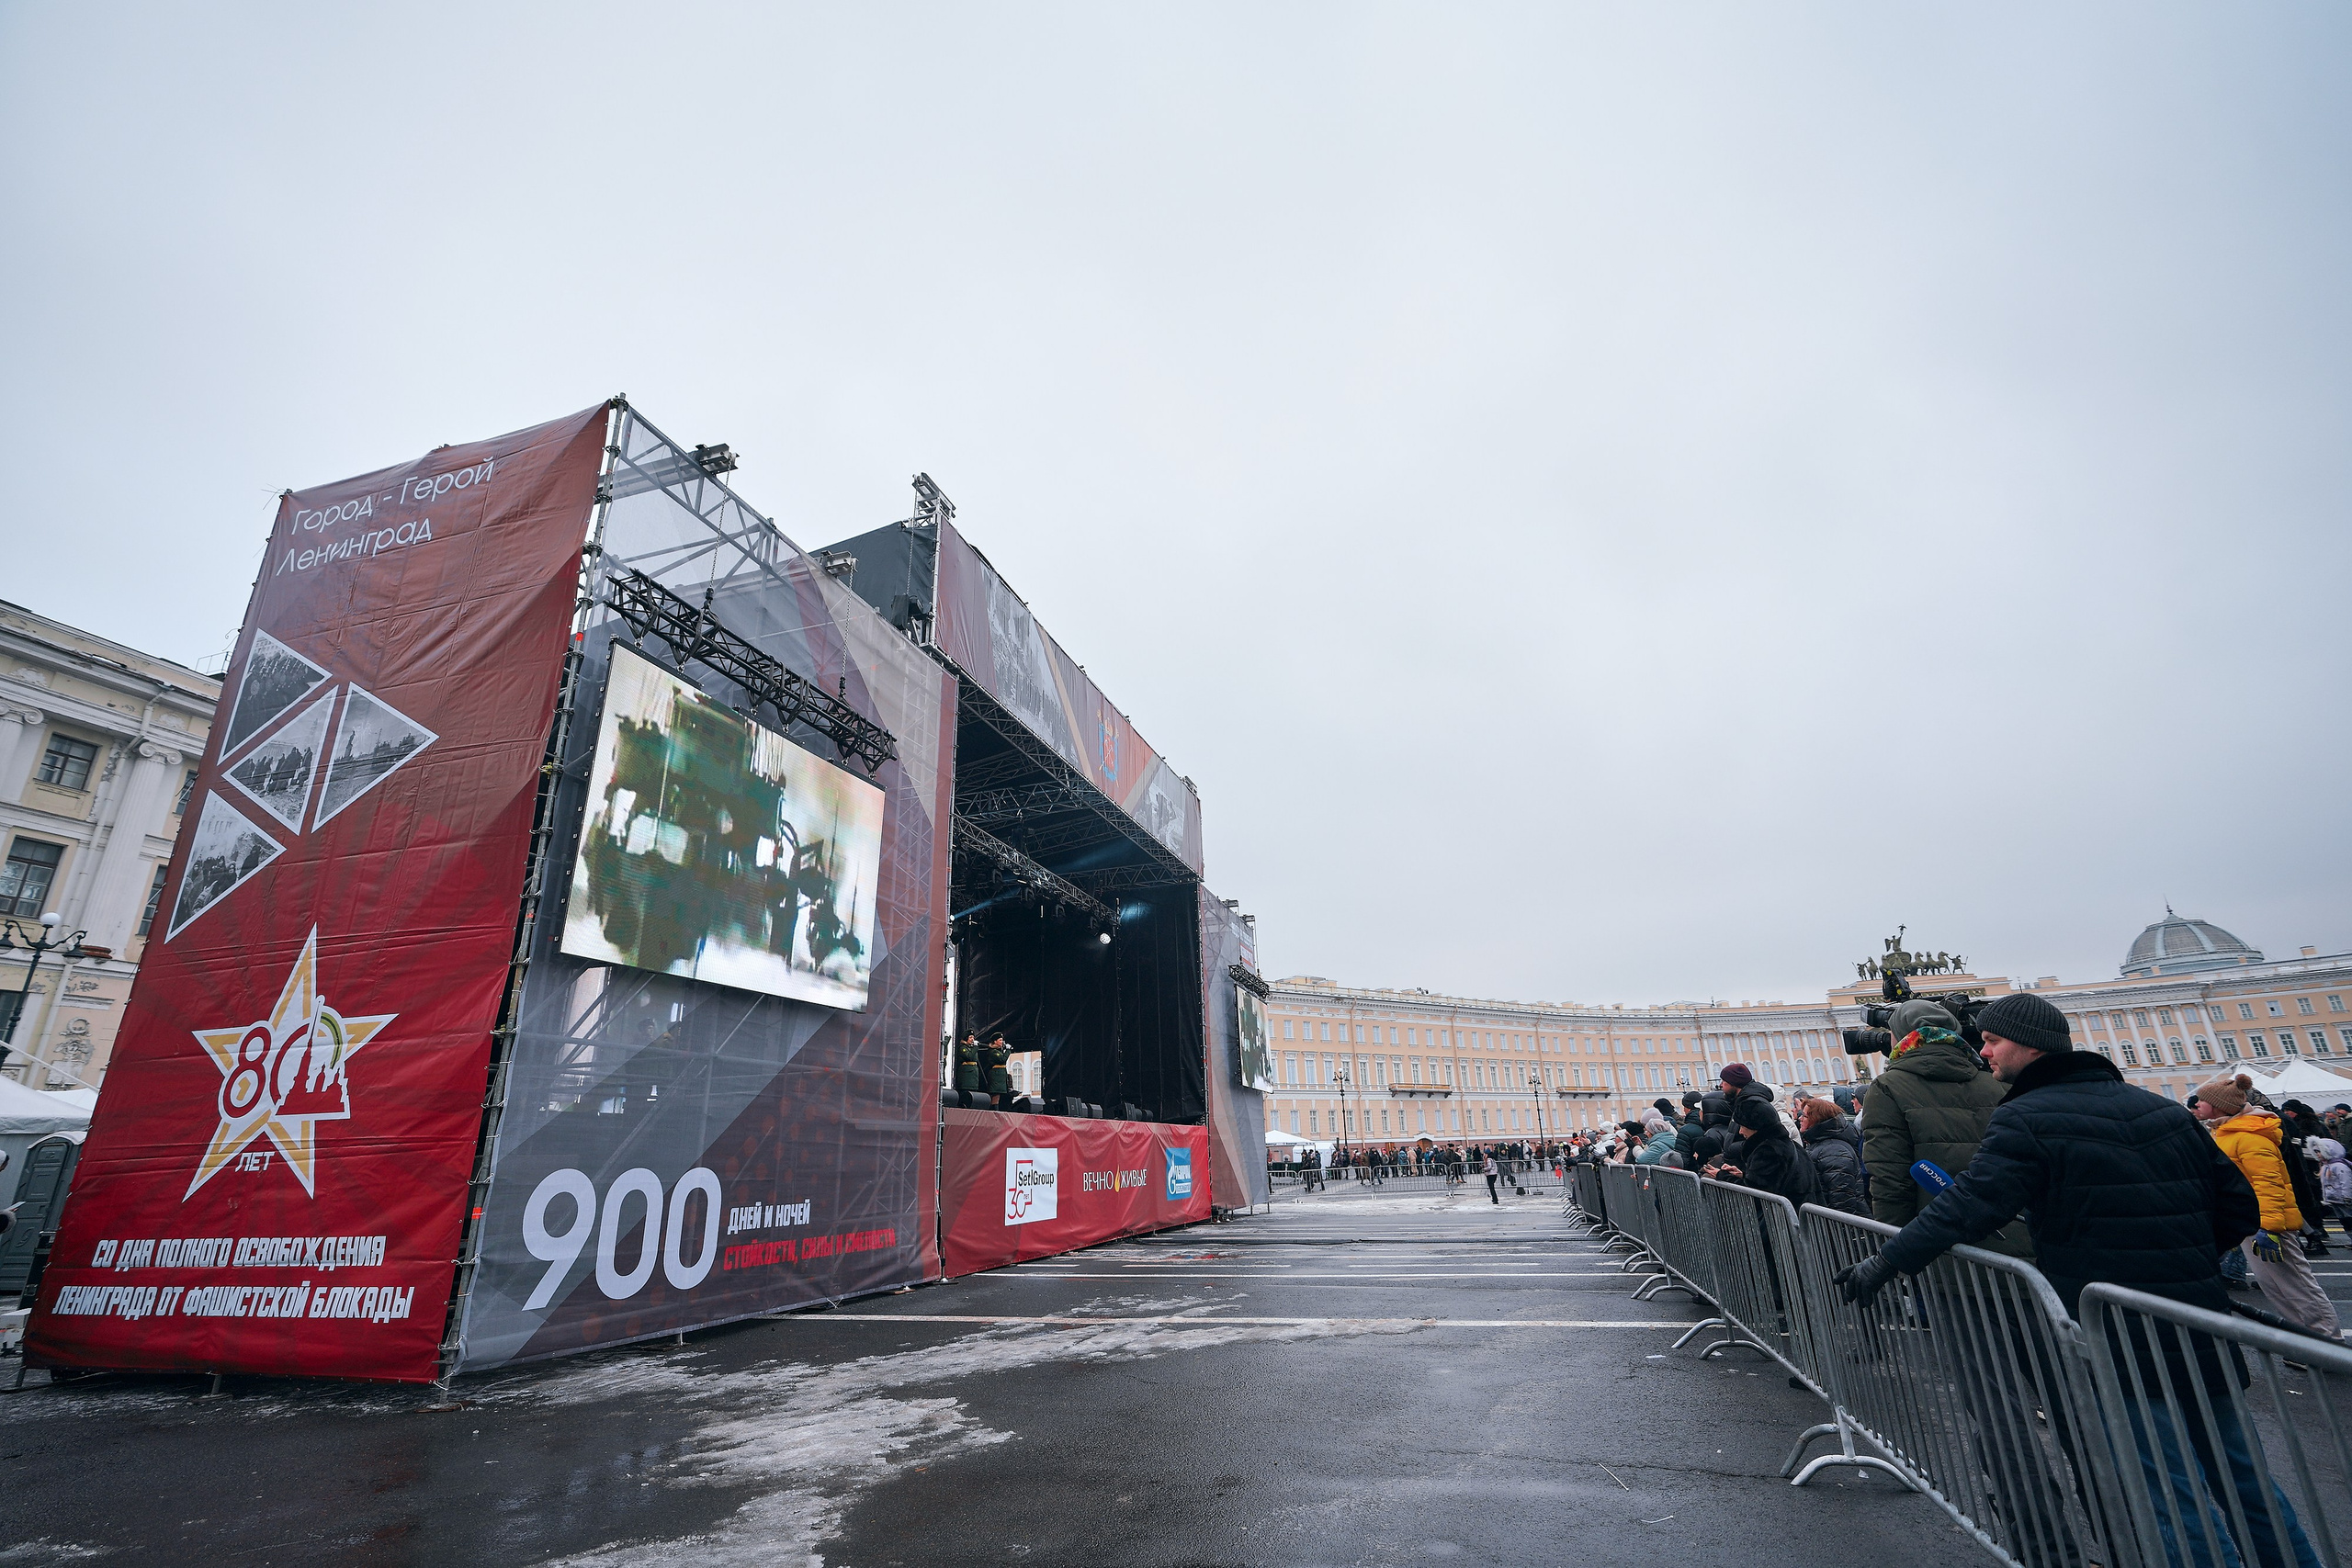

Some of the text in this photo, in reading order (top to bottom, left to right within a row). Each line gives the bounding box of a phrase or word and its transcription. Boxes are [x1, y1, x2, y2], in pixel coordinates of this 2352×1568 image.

[291, 494, 373, 536] Город
[399, 457, 495, 504] Герой
[276, 517, 433, 576] Ленинград
[234, 1151, 276, 1173] ЛЕТ
[1082, 1168, 1148, 1192] ВЕЧНО ЖИВЫЕ
[1918, 1163, 1947, 1187] РОССИЯ
[727, 1199, 811, 1235] ДНЕЙ И НОЧЕЙ
[91, 1235, 387, 1272] СО ДНЯ ПОЛНОГО ОСВОБОЖДЕНИЯ
[521, 1167, 723, 1312] 900
[723, 1228, 897, 1271] СТОЙКОСТИ, СИЛЫ И СМЕЛОСТИ
[51, 1280, 415, 1324] ЛЕНИНГРАДА ОТ ФАШИСТСКОЙ БЛОКАДЫ
